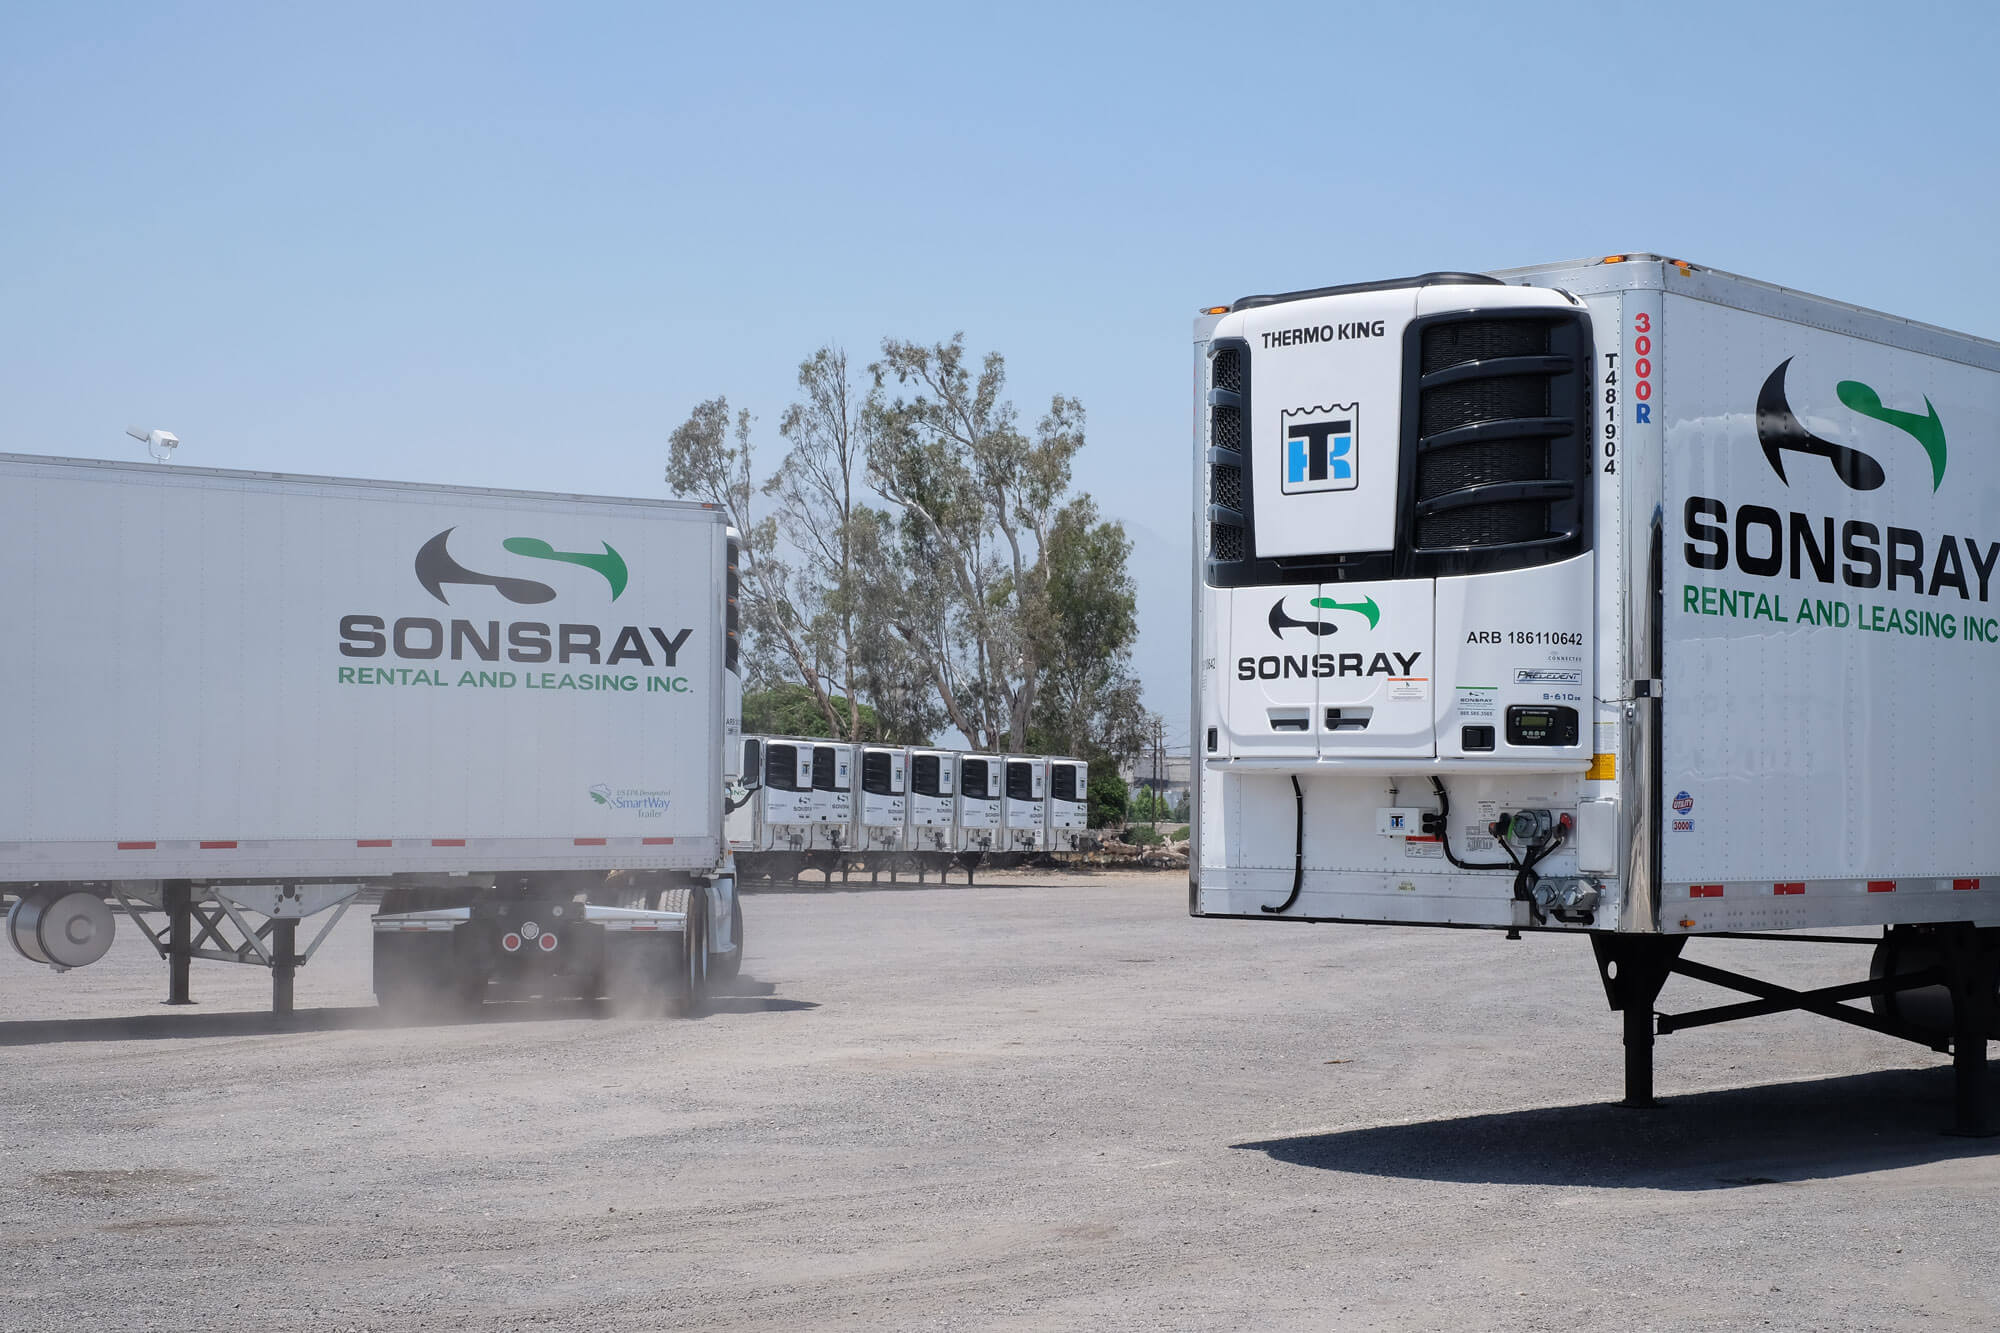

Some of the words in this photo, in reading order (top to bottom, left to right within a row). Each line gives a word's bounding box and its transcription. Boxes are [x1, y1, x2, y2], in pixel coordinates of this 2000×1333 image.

[1262, 325, 1334, 349] THERMO
[1338, 320, 1385, 340] KING
[1635, 313, 1651, 424] 3000R
[1604, 353, 1618, 475] T481904
[1684, 496, 2000, 602] SONSRAY
[1683, 584, 1788, 623] RENTAL
[1796, 598, 1850, 628] AND
[1858, 603, 1957, 639] LEASING
[339, 614, 694, 667] SONSRAY
[1466, 632, 1502, 644] ARB
[1508, 632, 1583, 645] 186110642
[338, 667, 449, 687] RENTAL
[457, 671, 517, 688] AND
[526, 673, 638, 692] LEASING
[647, 676, 694, 693] INC.
[1238, 652, 1421, 680] SONSRAY
[1517, 670, 1580, 680] PRECEDENT
[616, 797, 671, 811] SmartWay
[638, 809, 661, 818] Trailer
